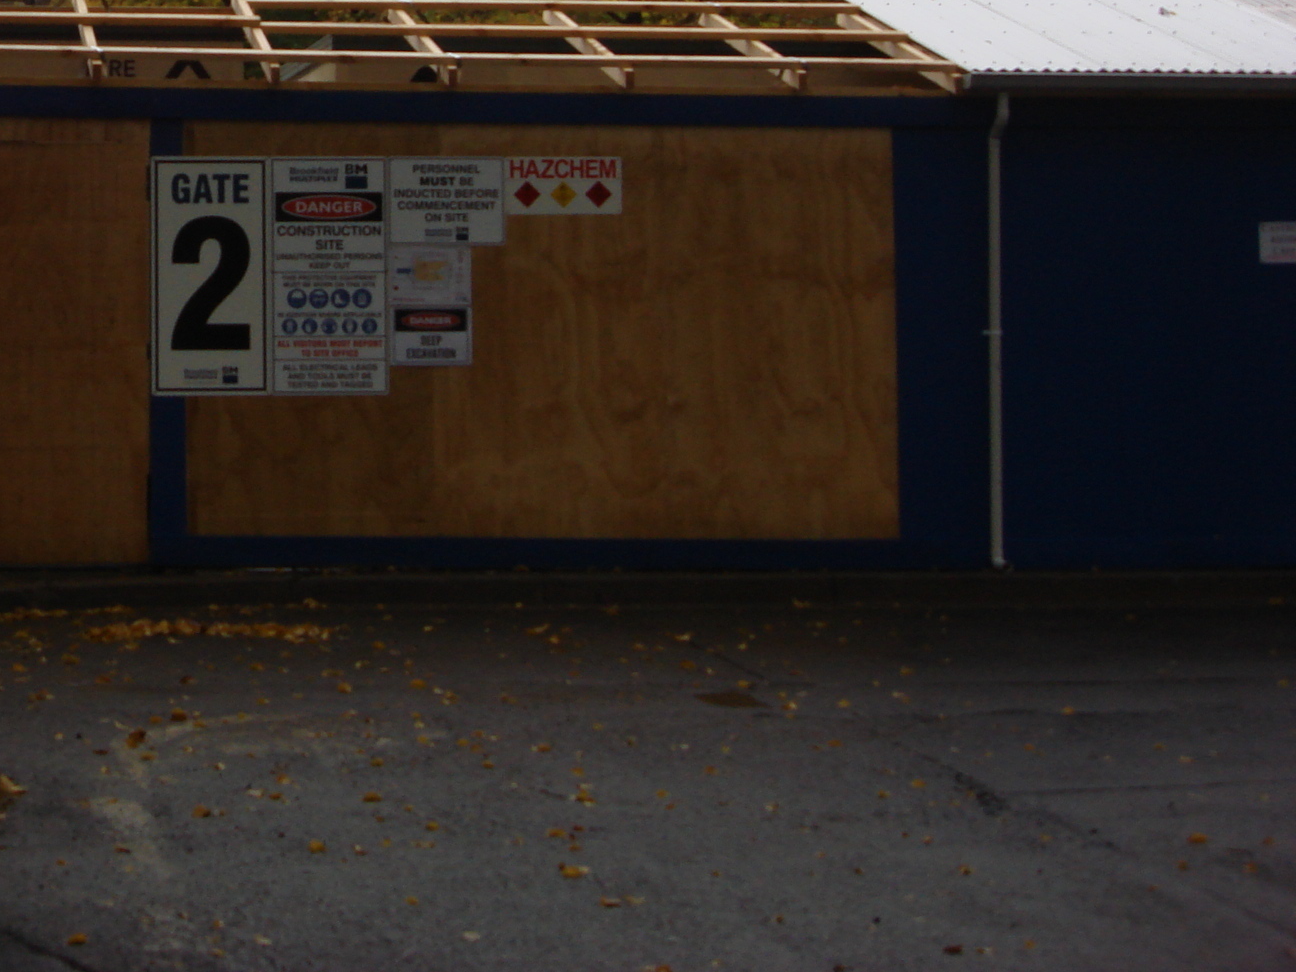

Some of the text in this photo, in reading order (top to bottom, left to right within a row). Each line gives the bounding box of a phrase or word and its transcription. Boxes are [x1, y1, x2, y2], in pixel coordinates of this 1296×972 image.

[344, 163, 368, 175] BM
[412, 164, 480, 174] PERSONNEL
[509, 159, 617, 179] HAZCHEM
[419, 176, 473, 186] MUST BE
[171, 173, 249, 204] GATE
[393, 189, 499, 198] INDUCTED BEFORE
[295, 201, 363, 213] DANGER
[397, 200, 496, 210] COMMENCEMENT
[424, 213, 469, 222] ON SITE
[277, 225, 382, 237] CONSTRUCTION
[315, 239, 344, 250] SITE
[171, 215, 251, 350] 2
[409, 317, 452, 325] DANGER
[277, 340, 290, 348] ALL
[406, 348, 457, 359] EXCAVATION
